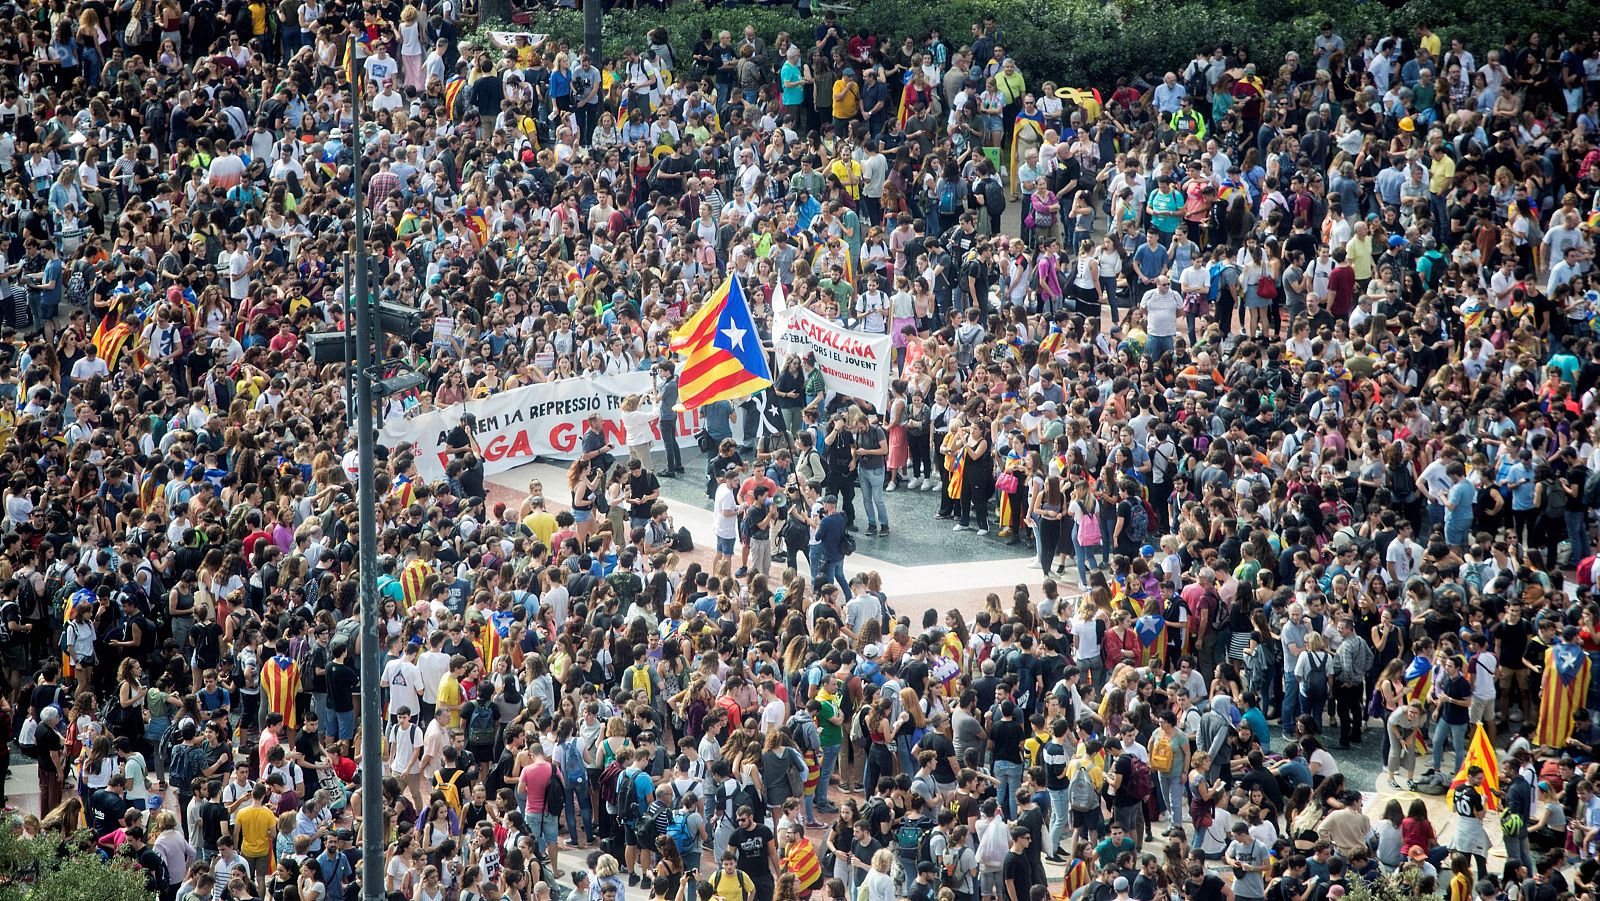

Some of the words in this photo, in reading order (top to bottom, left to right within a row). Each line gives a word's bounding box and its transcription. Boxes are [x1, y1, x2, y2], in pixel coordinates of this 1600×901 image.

[801, 319, 876, 360] CATALANA
[833, 353, 842, 363] EL
[845, 356, 877, 371] JOVENT
[504, 409, 524, 427] LA
[529, 393, 601, 419] REPRESSIÓ
